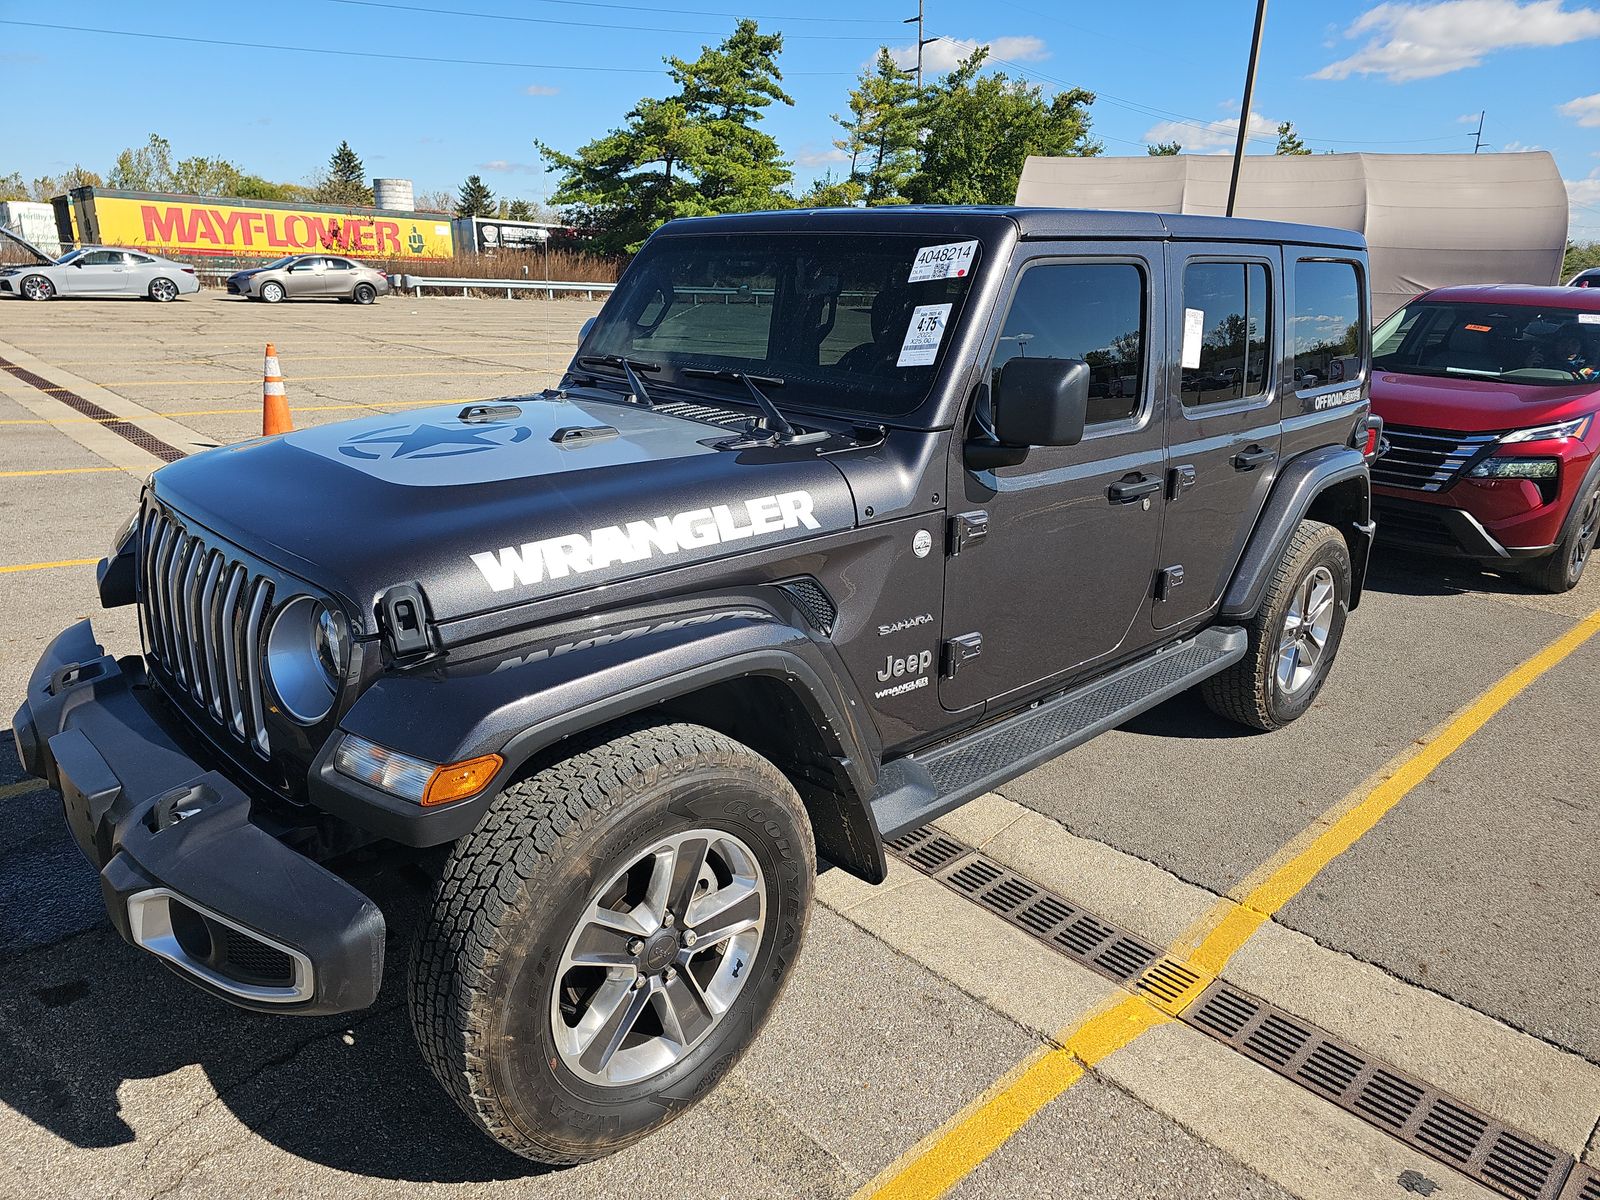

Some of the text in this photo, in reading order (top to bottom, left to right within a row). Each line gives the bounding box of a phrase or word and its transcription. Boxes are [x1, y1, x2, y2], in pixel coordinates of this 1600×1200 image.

[141, 205, 401, 252] MAYFLOWER
[917, 245, 972, 264] 4048214
[917, 316, 938, 331] 4:75
[469, 490, 822, 593] WRANGLER
[877, 613, 934, 636] SAHARA
[876, 649, 932, 682] Jeep
[874, 676, 929, 699] WRANGLER
[722, 799, 802, 985] GOODYEAR
